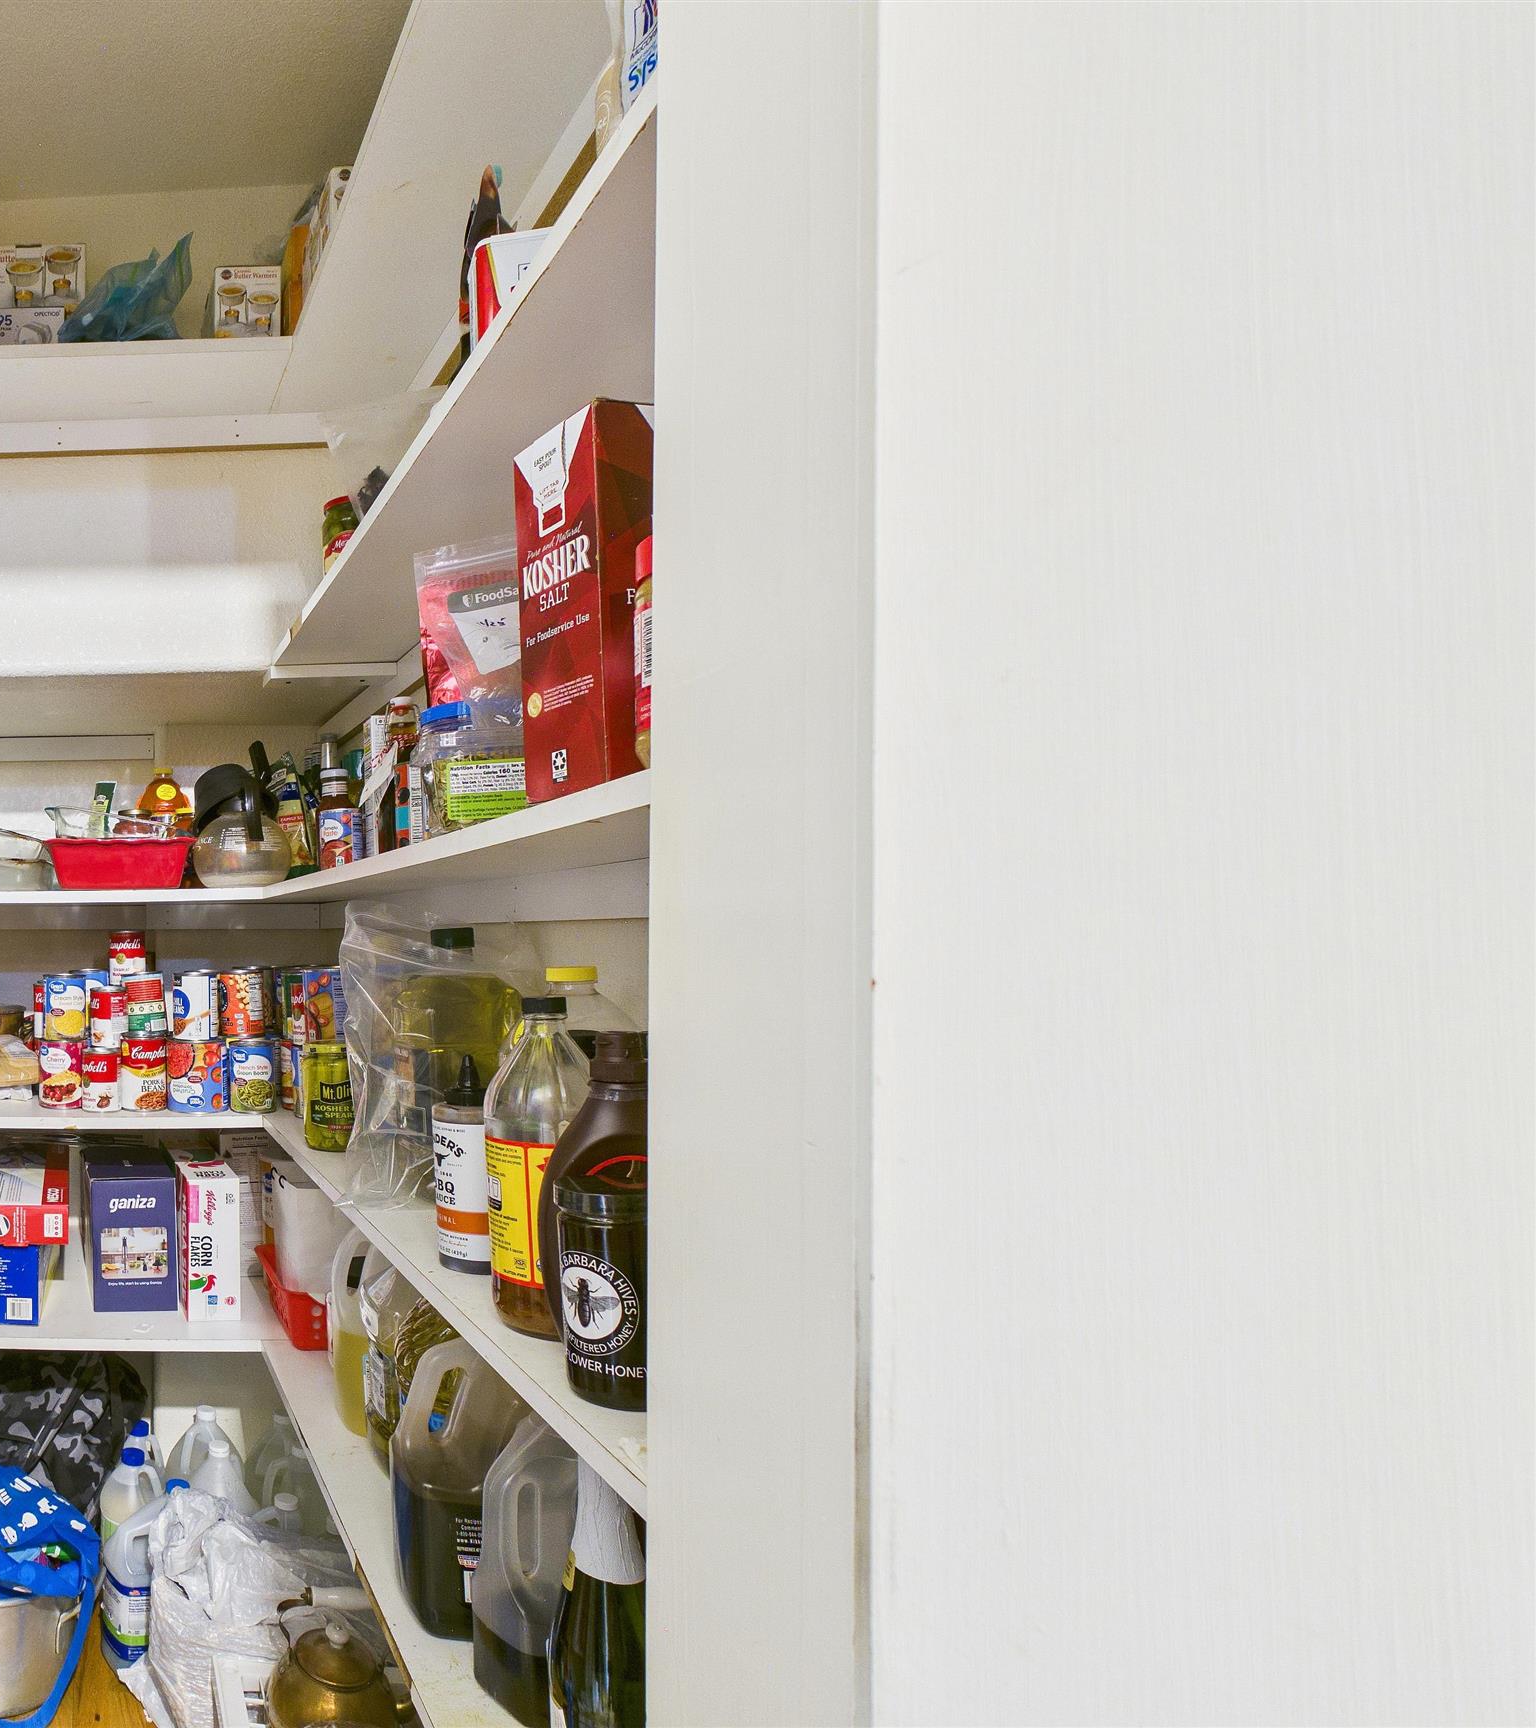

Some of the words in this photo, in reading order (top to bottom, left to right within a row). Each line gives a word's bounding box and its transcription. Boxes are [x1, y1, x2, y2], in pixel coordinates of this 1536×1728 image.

[526, 548, 540, 563] Pure
[541, 538, 555, 553] and
[555, 520, 582, 546] Natural
[522, 534, 592, 601] KOSHER
[539, 582, 570, 613] SALT
[525, 636, 537, 649] For
[537, 619, 575, 643] Foodservice
[575, 613, 591, 626] Use
[46, 1056, 65, 1065] Cherry
[141, 1084, 166, 1092] BEANS
[322, 1085, 336, 1099] Mt.
[314, 1104, 349, 1112] KOSHER
[109, 1194, 157, 1213] ganiza
[205, 1190, 217, 1226] Kellogg's
[190, 1235, 201, 1267] FLAKES
[200, 1235, 213, 1267] CORN
[563, 1253, 615, 1281] BARBARA
[613, 1278, 638, 1316] HIVES
[606, 1321, 635, 1350] HONEY
